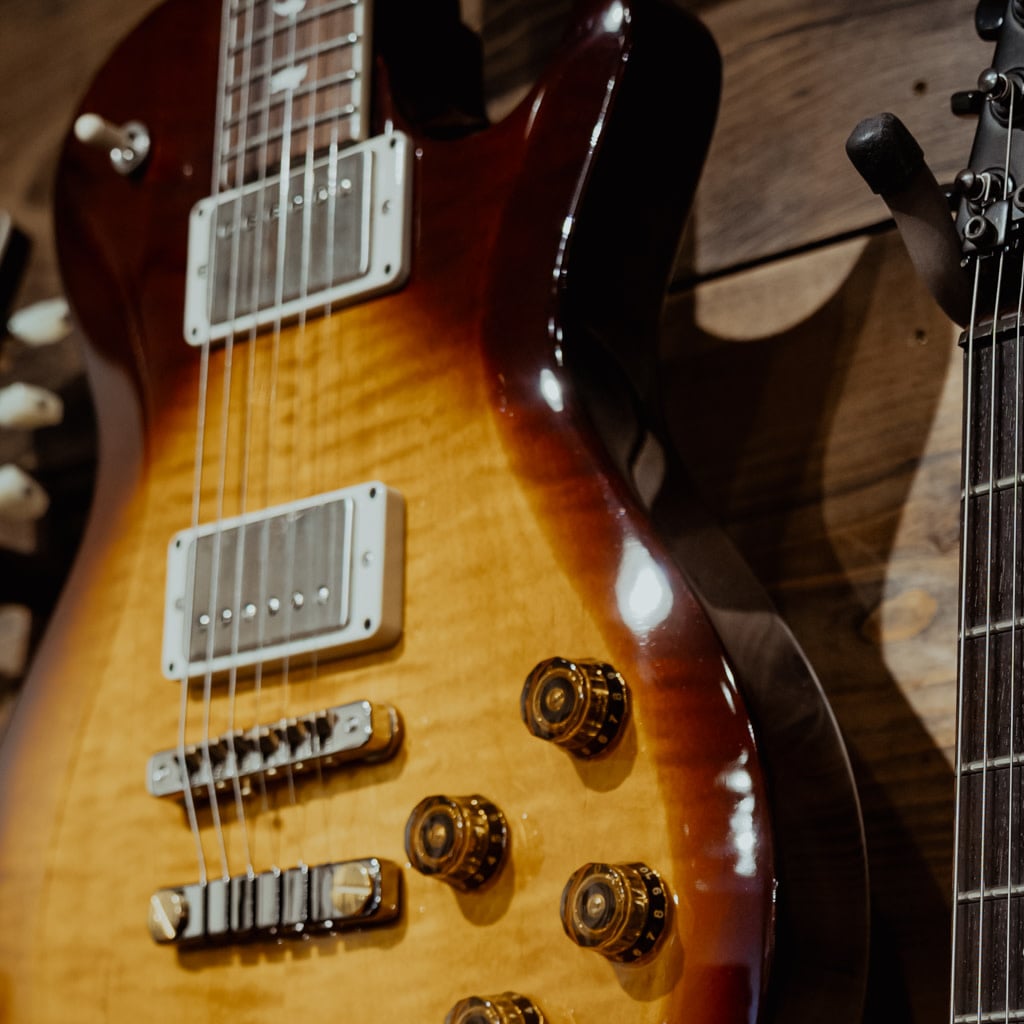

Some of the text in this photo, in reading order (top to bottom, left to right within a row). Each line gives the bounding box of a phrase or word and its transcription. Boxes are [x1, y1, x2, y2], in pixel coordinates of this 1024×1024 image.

[639, 866, 654, 880] 10
[653, 909, 664, 919] 8
[647, 931, 656, 941] 7
